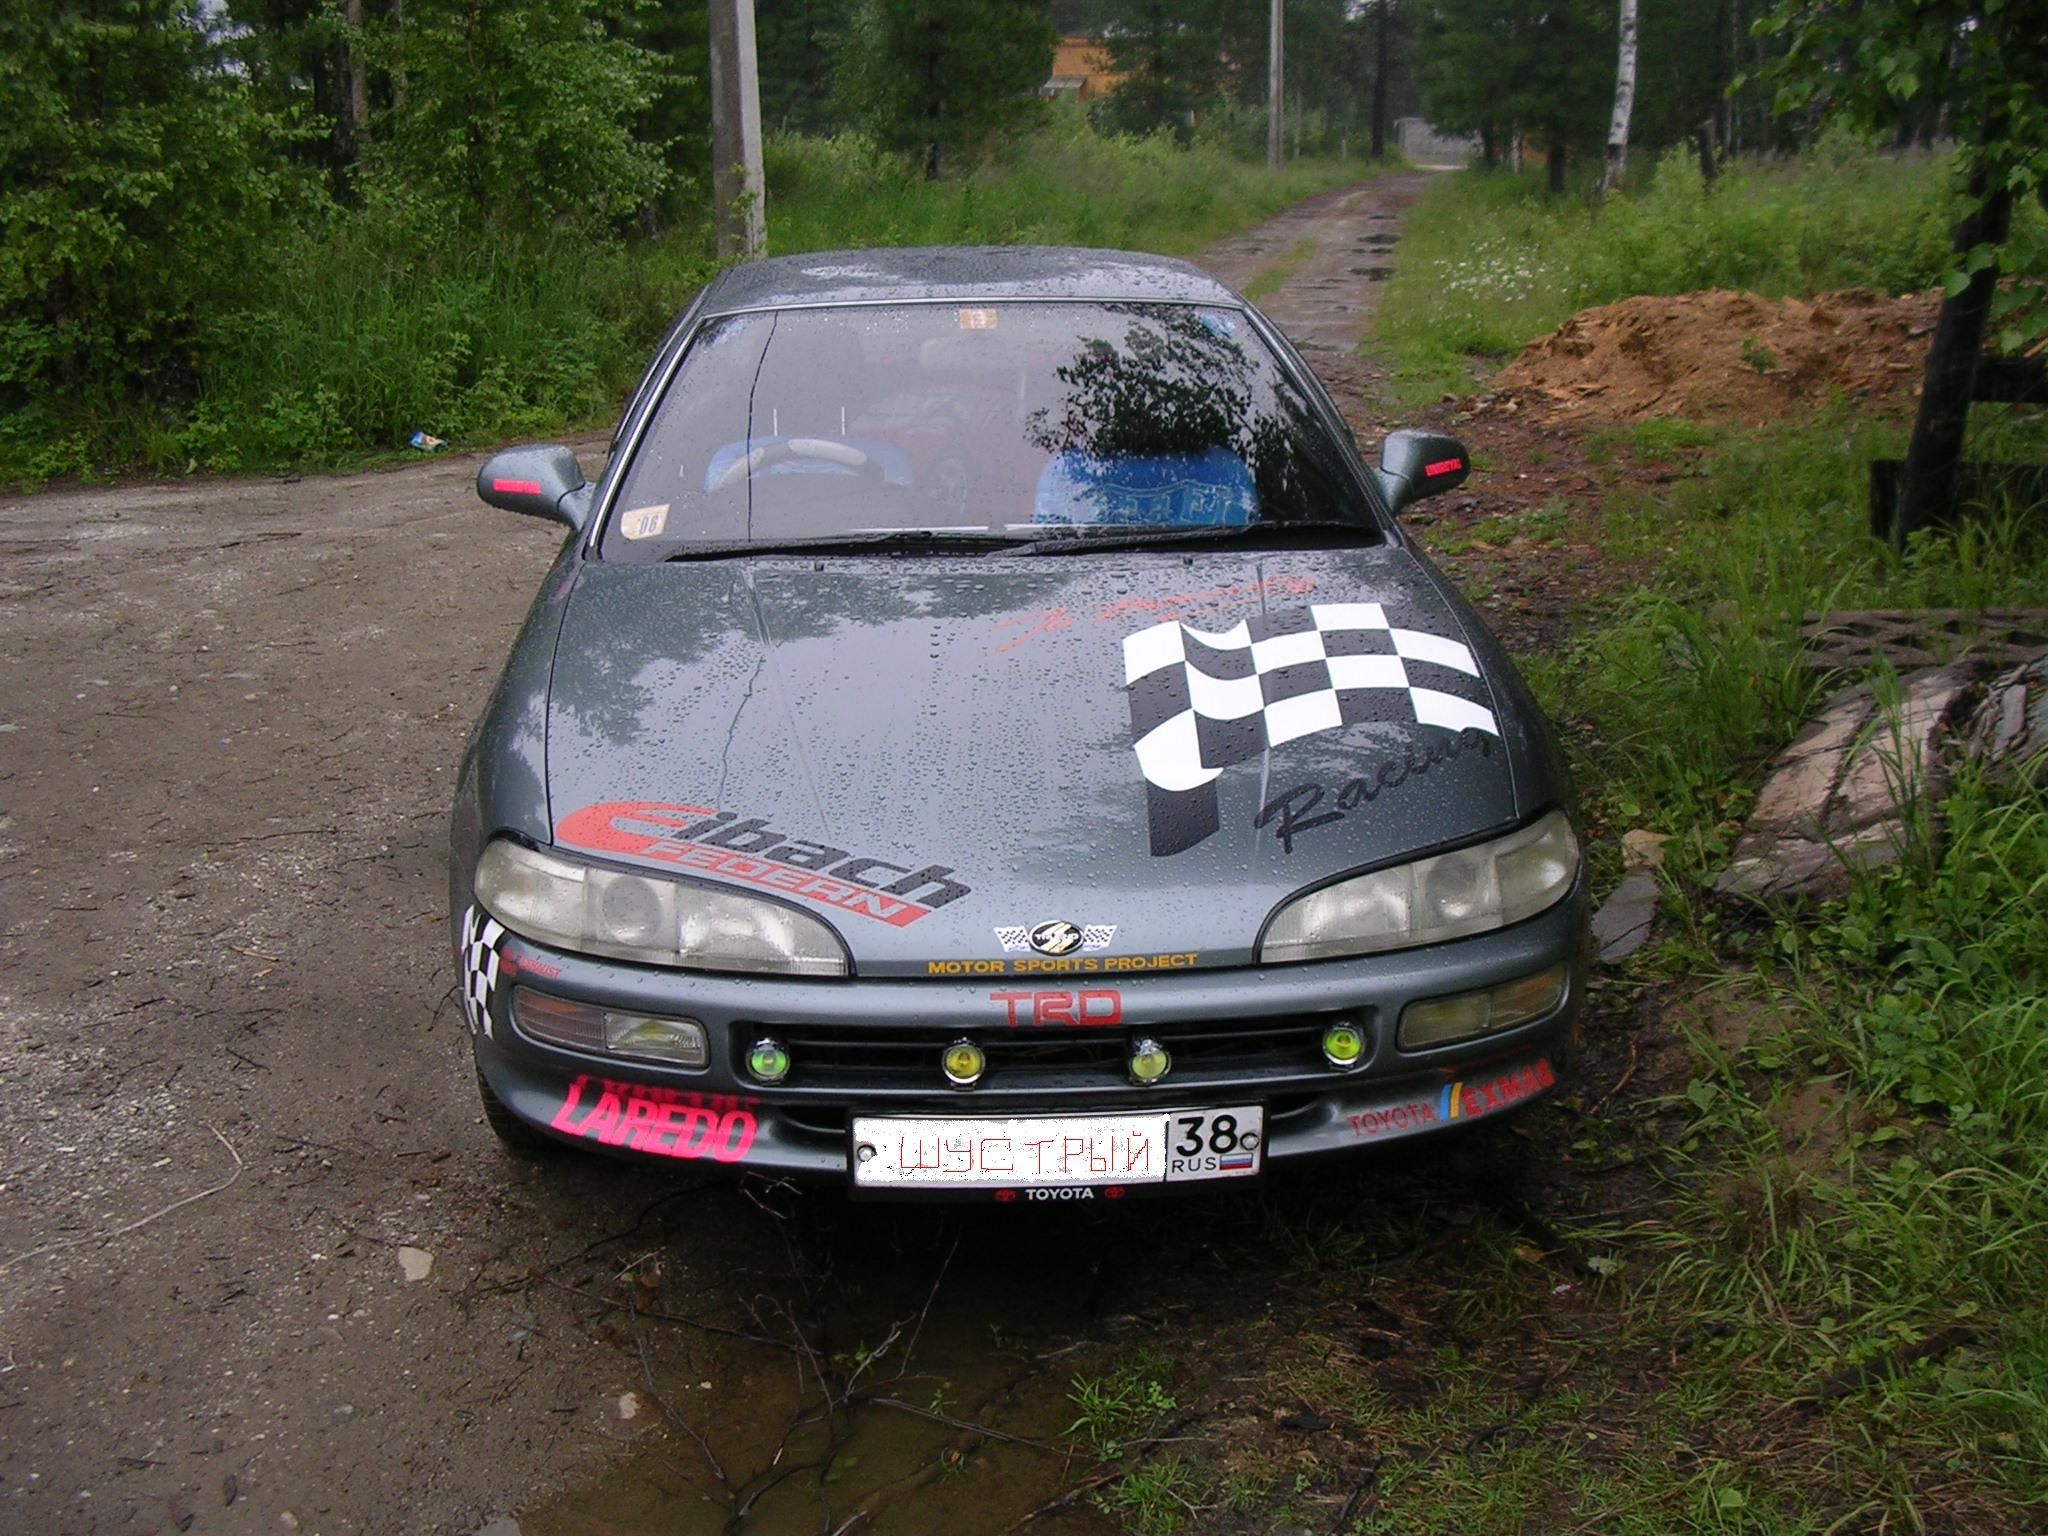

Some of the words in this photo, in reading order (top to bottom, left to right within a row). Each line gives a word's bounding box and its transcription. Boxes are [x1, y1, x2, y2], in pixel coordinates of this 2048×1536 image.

[1254, 727, 1490, 854] Racing
[555, 801, 972, 908] Eibach
[641, 842, 909, 919] FEDERN
[927, 959, 1005, 974] MOTOR
[1013, 957, 1099, 972] SPORTS
[1104, 953, 1198, 970] PROJECT
[989, 989, 1123, 1028] TRD
[551, 1080, 758, 1163] LAREDO
[1176, 1114, 1238, 1157] 38
[1347, 1103, 1440, 1137] TOYOTA
[1171, 1156, 1217, 1173] RUS
[1026, 1187, 1095, 1201] TOYOTA
